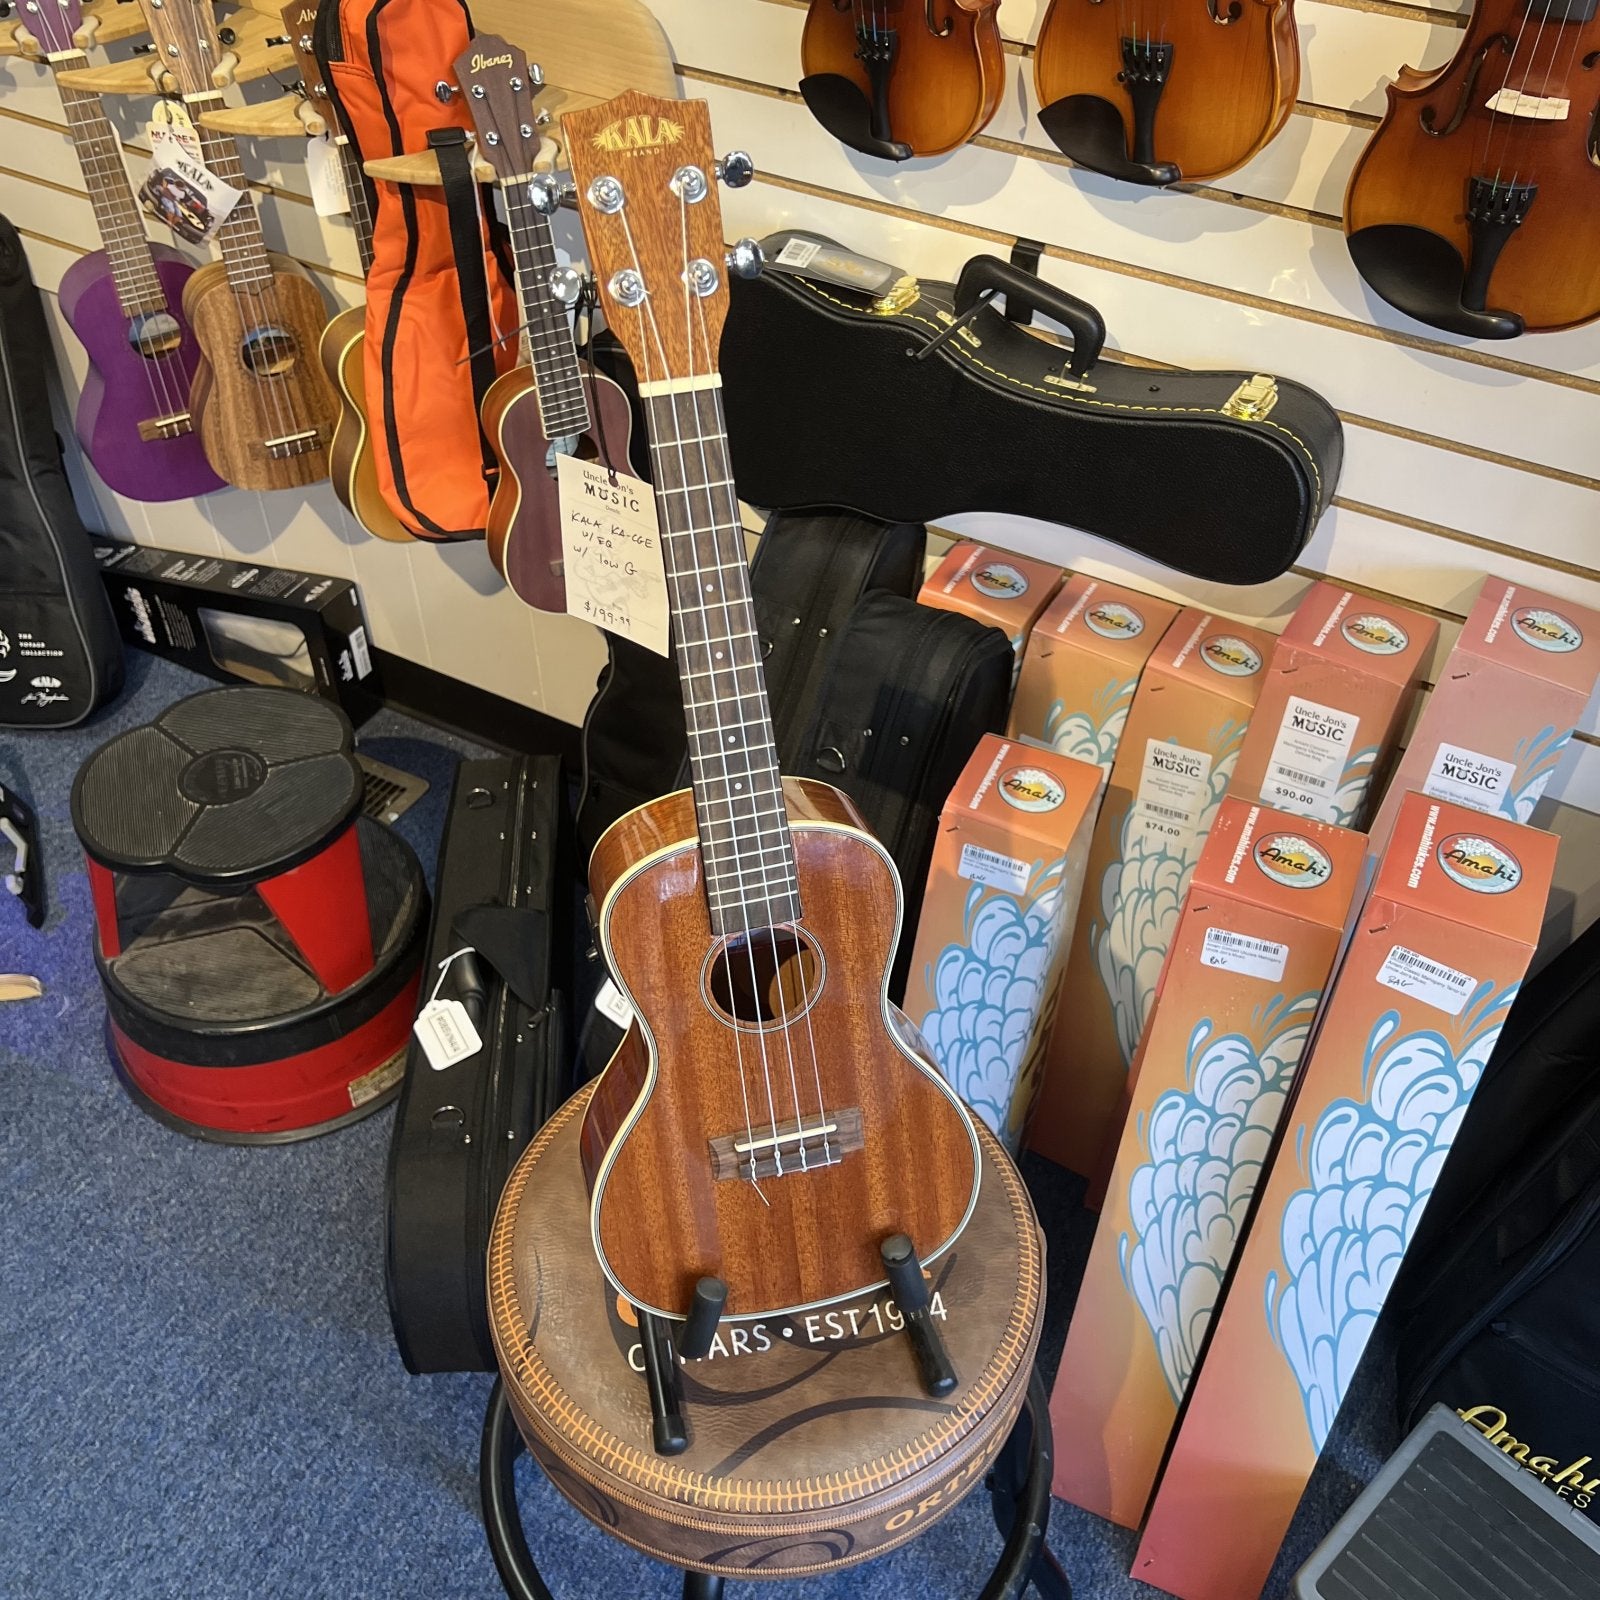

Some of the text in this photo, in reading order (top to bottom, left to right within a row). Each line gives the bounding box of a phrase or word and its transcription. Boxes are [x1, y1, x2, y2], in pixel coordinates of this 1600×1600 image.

[470, 53, 513, 74] Ibanez
[597, 114, 682, 152] KALA
[625, 147, 661, 158] BRAND
[583, 470, 608, 486] Uncle
[583, 482, 640, 513] MUSIC
[571, 510, 654, 549] KALA KA-CGE
[597, 536, 613, 549] EQ
[573, 545, 588, 558] w/
[624, 561, 638, 576] G
[975, 571, 1025, 593] Amahi
[583, 600, 631, 627] $199.99
[1089, 610, 1140, 634] Amahi
[1346, 623, 1404, 650] Amahi
[1517, 617, 1578, 646] Amahi
[1205, 644, 1258, 671] Amahi
[1291, 715, 1344, 741] MUSIC
[1294, 705, 1347, 729] Uncle Jon's
[1152, 756, 1200, 778] MUSIC
[1153, 746, 1202, 766] Uncle Jon's
[1445, 753, 1502, 777] Uncle Jon's
[1441, 763, 1498, 790] MUSIC
[1003, 778, 1061, 805] Amahi
[1274, 786, 1314, 805] $90.00
[1145, 822, 1180, 837] $74.00
[1407, 804, 1441, 889] www.amahiukes.com
[1260, 847, 1327, 878] Amahi
[1443, 849, 1516, 882] Amahi
[804, 1308, 860, 1343] EST
[867, 1291, 948, 1334] 194
[1456, 1405, 1600, 1495] Amahi
